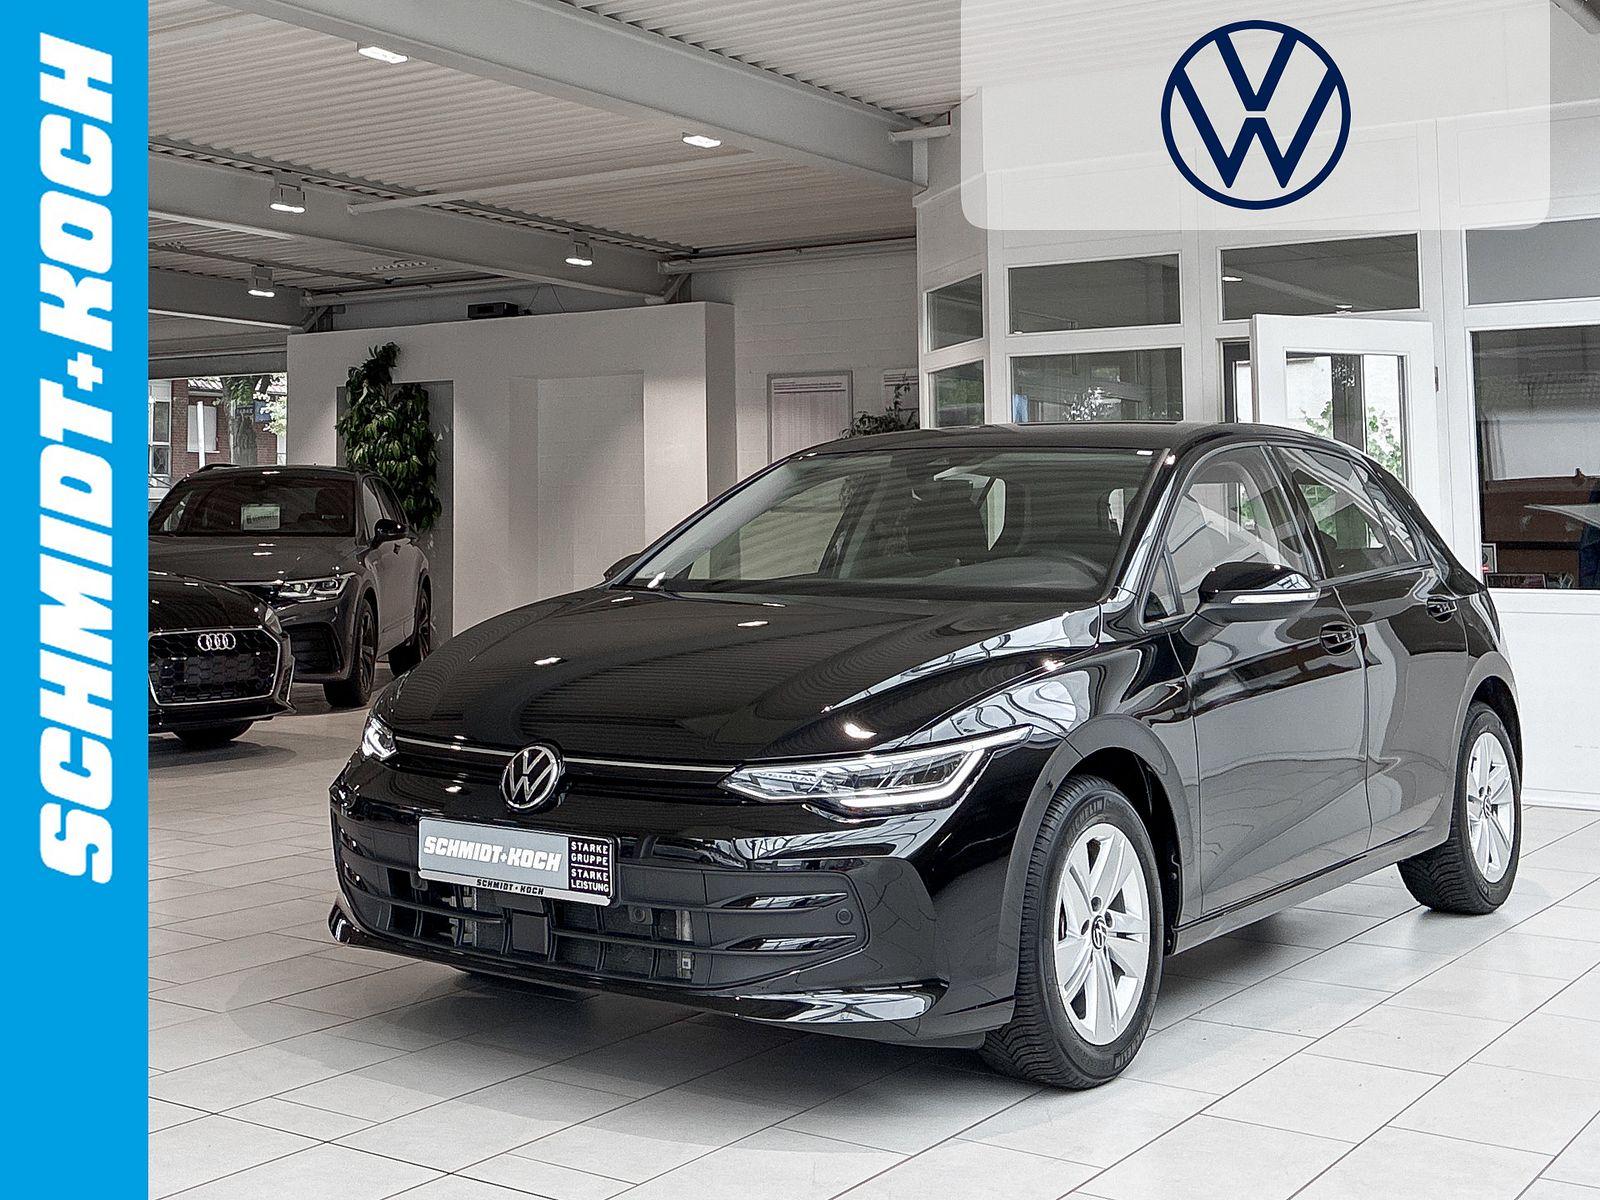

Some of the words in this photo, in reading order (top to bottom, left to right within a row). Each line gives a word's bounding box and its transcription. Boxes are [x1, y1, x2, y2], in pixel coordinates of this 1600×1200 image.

[423, 836, 562, 872] SCHMIDT+KOCH
[571, 841, 608, 854] STARKE
[571, 853, 608, 866] GRUPPE
[571, 868, 608, 881] STARKE
[571, 879, 609, 892] LEISTUNG
